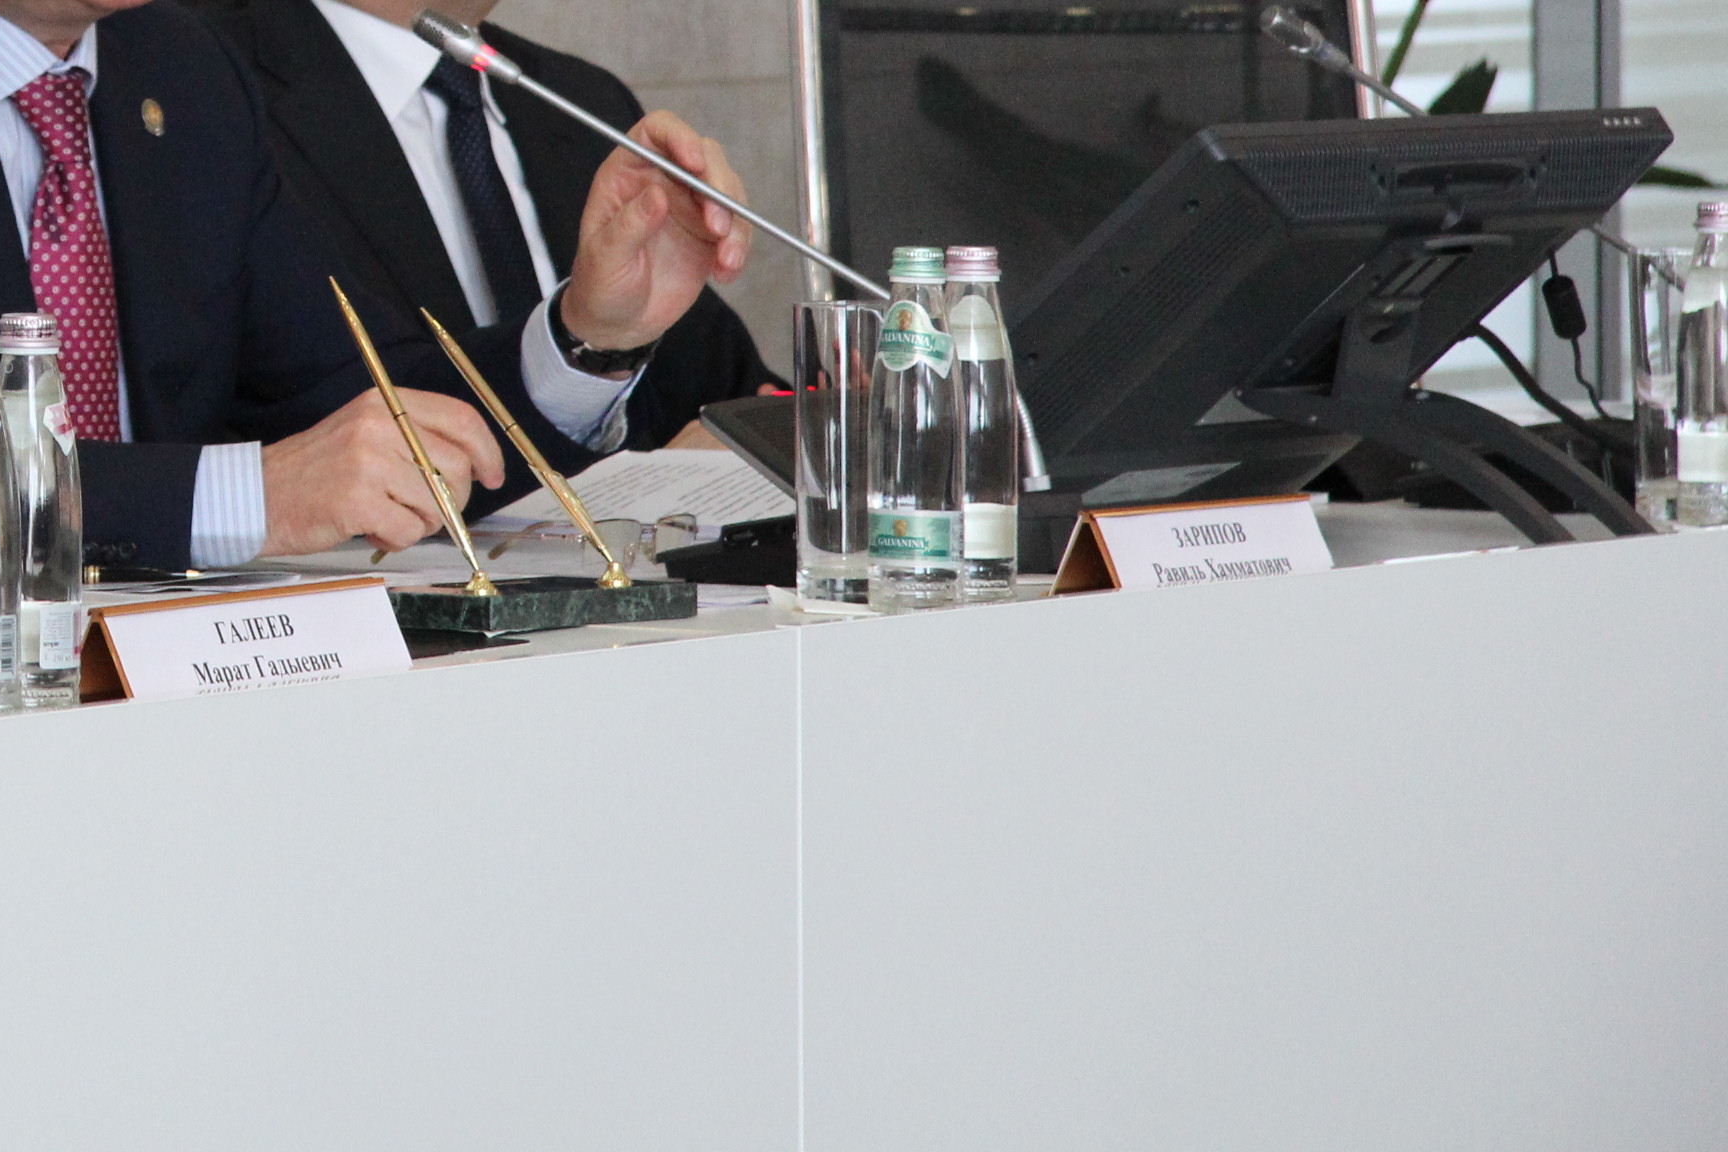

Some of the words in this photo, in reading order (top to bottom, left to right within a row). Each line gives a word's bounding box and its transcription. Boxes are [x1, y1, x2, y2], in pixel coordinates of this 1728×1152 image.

[1171, 522, 1246, 548] ЗАРИПОВ
[1152, 562, 1207, 584] Равиль
[1203, 557, 1293, 580] Хамматович
[213, 613, 295, 645] ГАЛЕЕВ
[191, 661, 252, 689] Марат
[253, 651, 343, 679] Гадыевич
